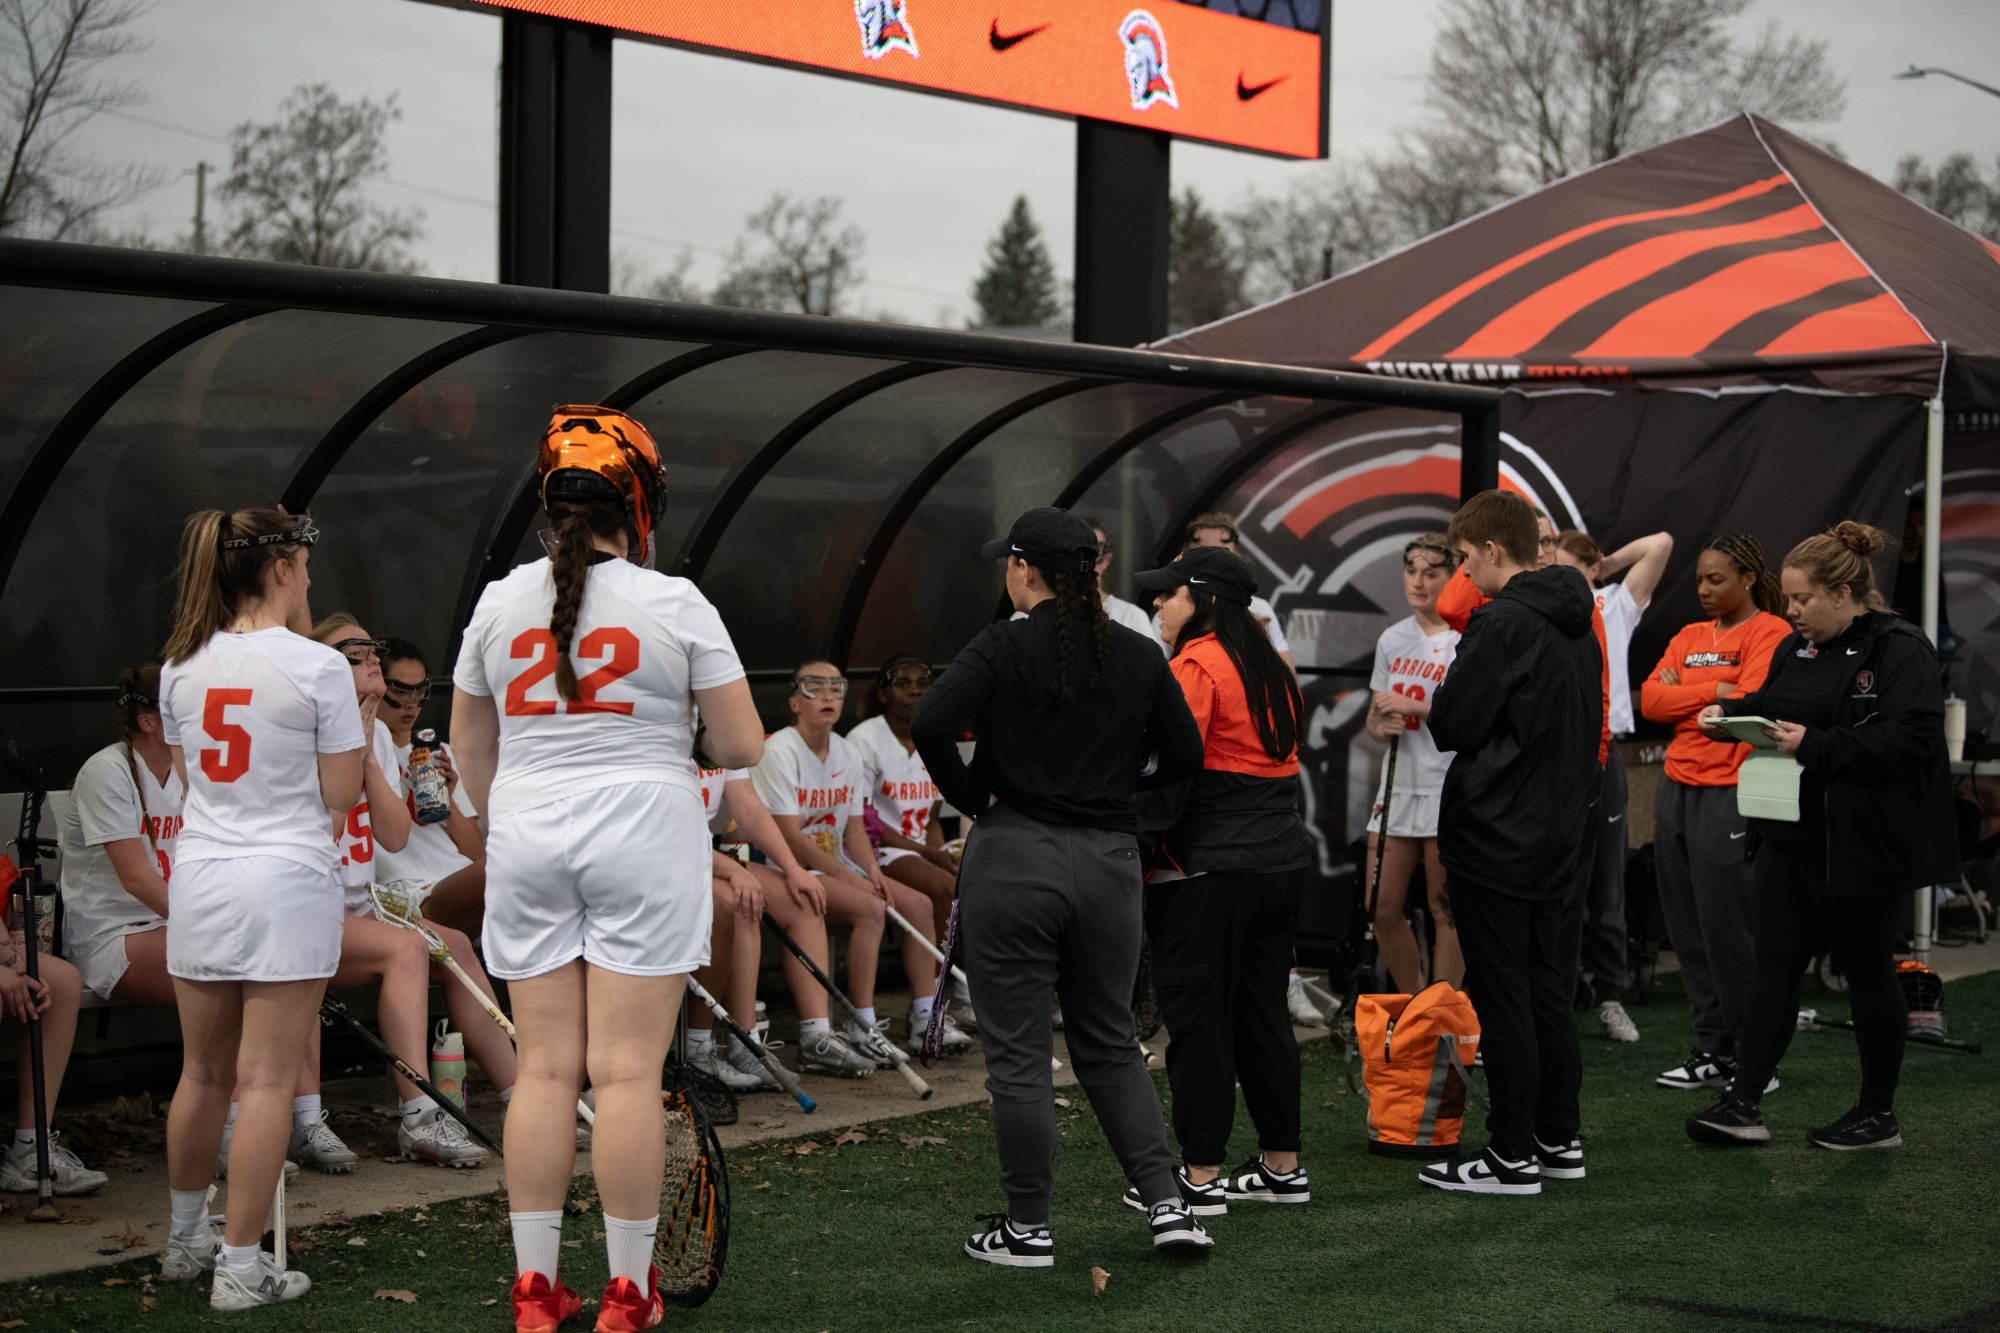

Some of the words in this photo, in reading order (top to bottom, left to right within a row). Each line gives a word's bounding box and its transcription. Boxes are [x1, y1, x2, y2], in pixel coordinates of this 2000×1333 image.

[1366, 361, 1521, 382] INDIANA
[224, 537, 250, 549] STX
[258, 533, 285, 544] STX
[505, 626, 640, 717] 22
[200, 688, 253, 784] 5
[336, 801, 374, 868] 5
[1156, 1205, 1170, 1215] NIKE
